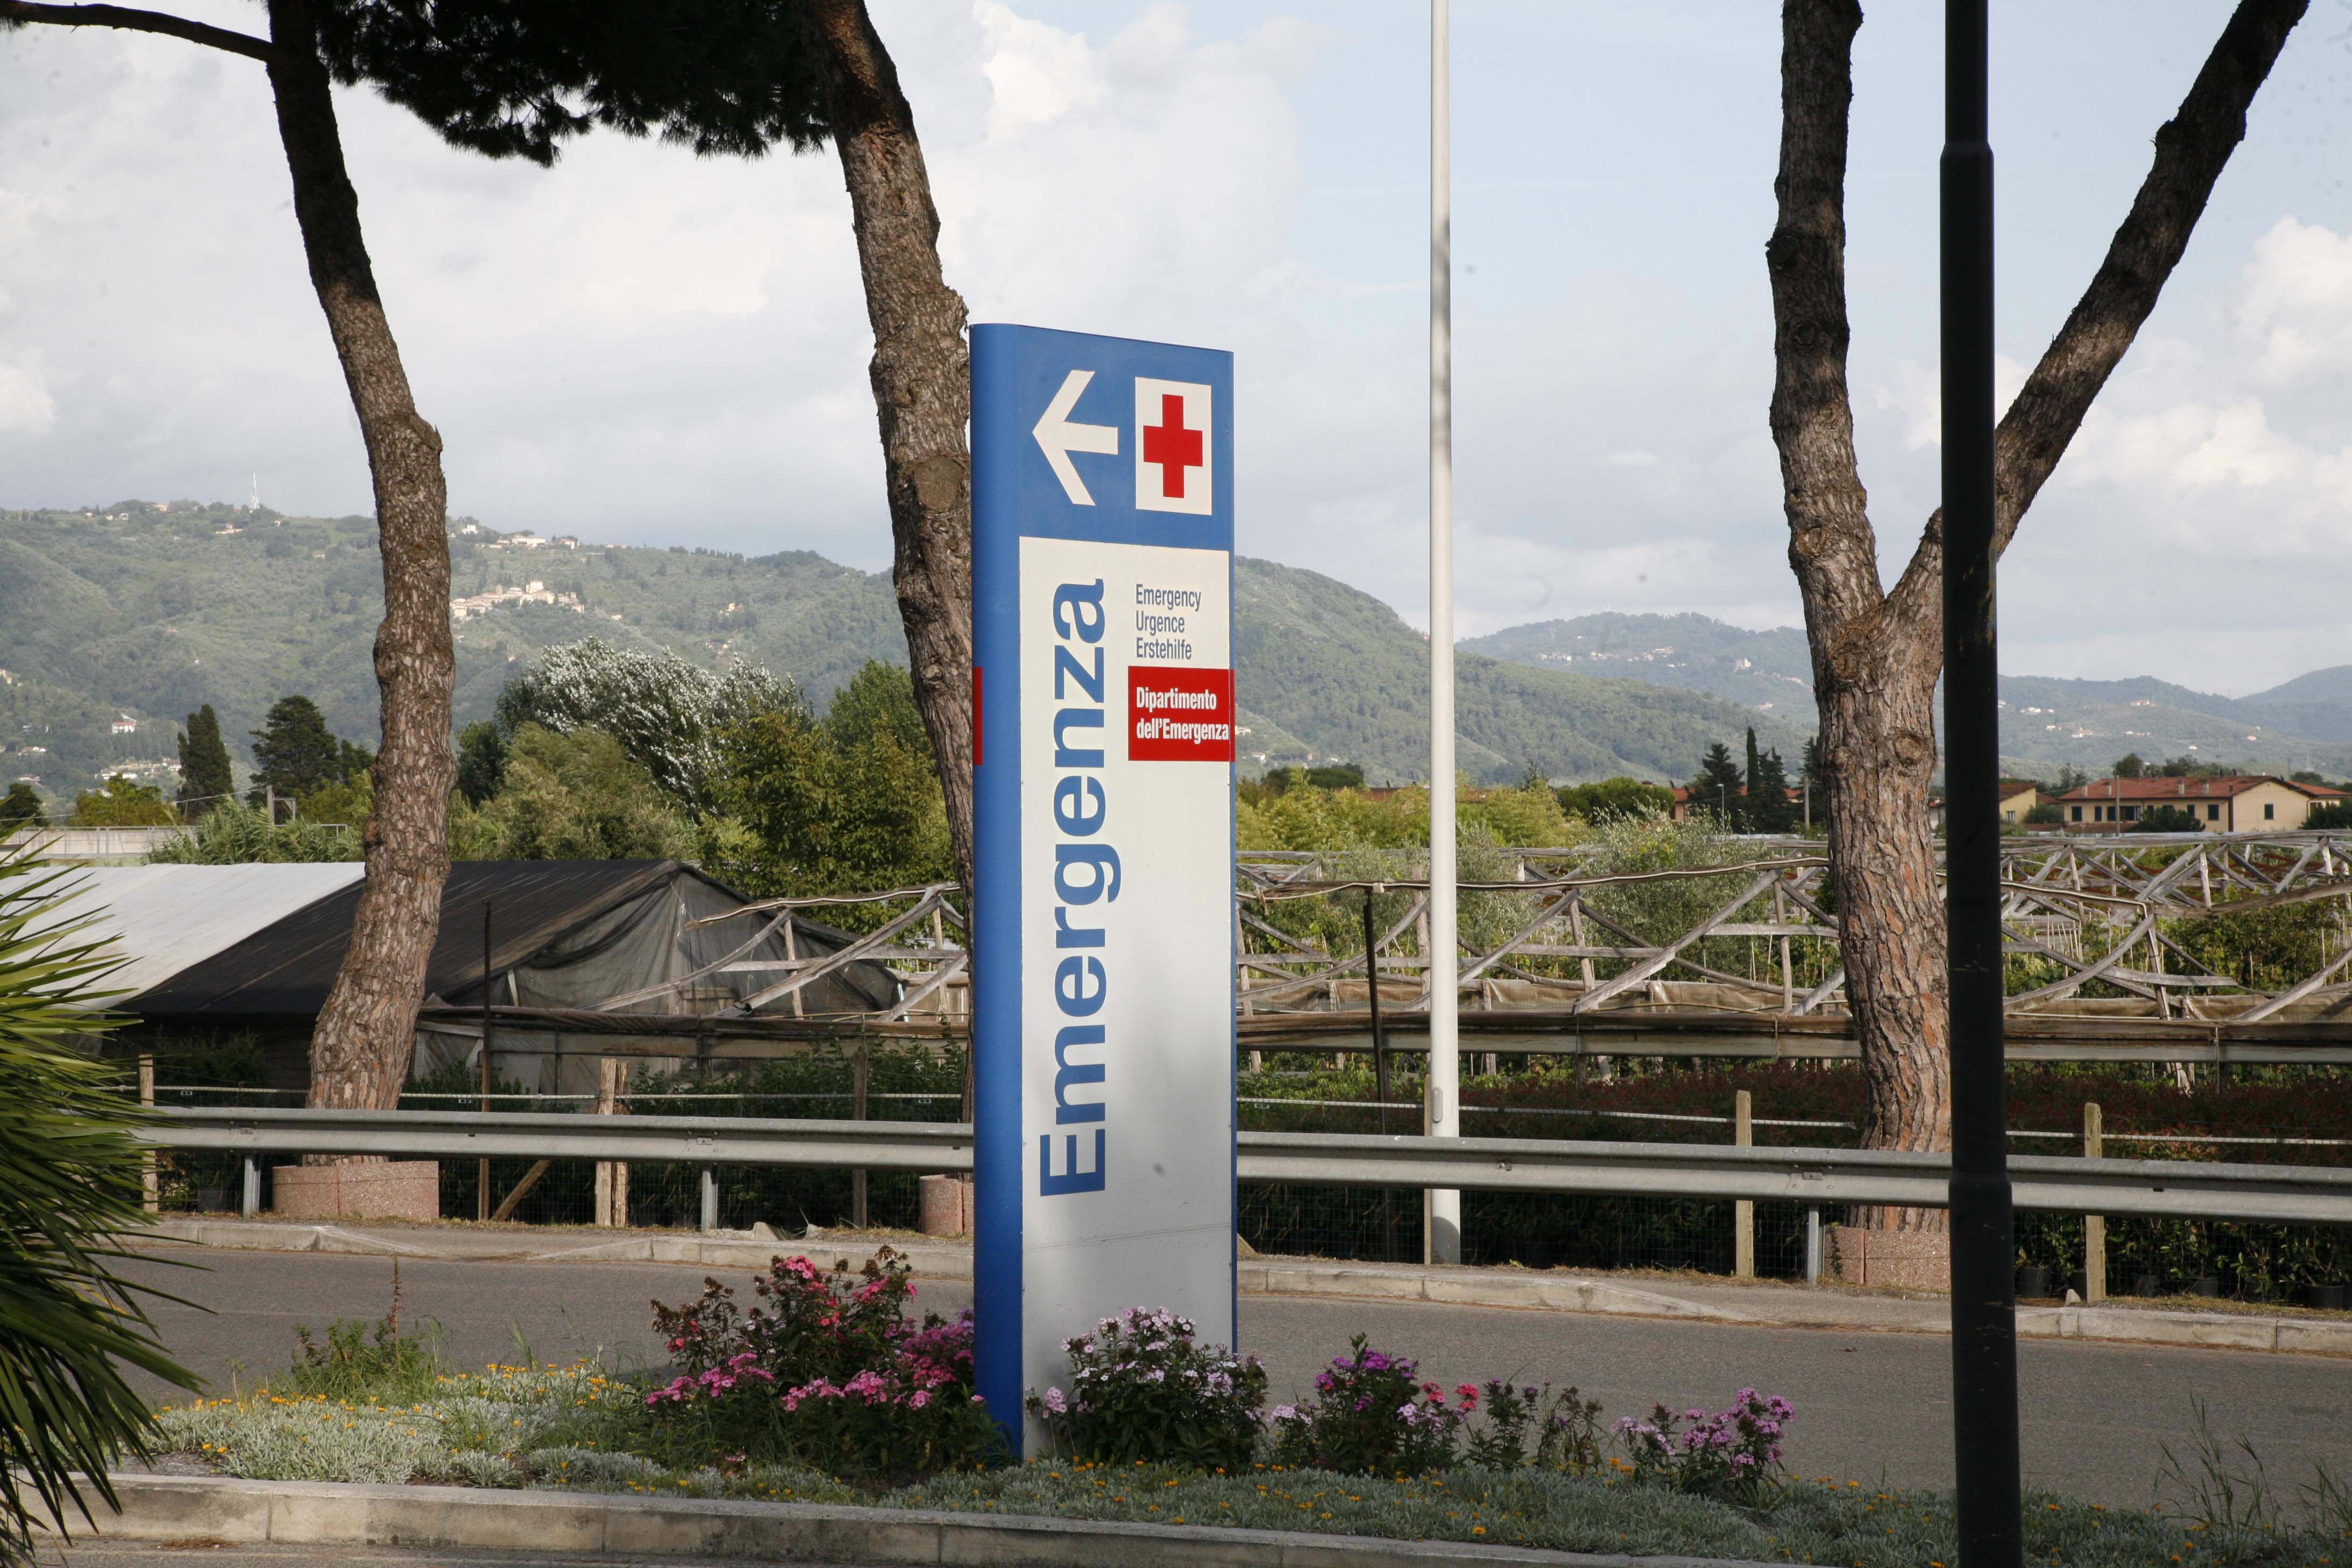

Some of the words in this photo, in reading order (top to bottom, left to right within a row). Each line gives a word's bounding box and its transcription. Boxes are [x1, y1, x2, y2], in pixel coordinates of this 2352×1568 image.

[1136, 584, 1201, 612] Emergency
[1136, 610, 1185, 636] Urgence
[1136, 637, 1192, 660] Erstehilfe
[1136, 687, 1217, 713] Dipartimento
[1136, 718, 1229, 745] dell'Emergenza
[1041, 579, 1121, 1196] Emergenza
